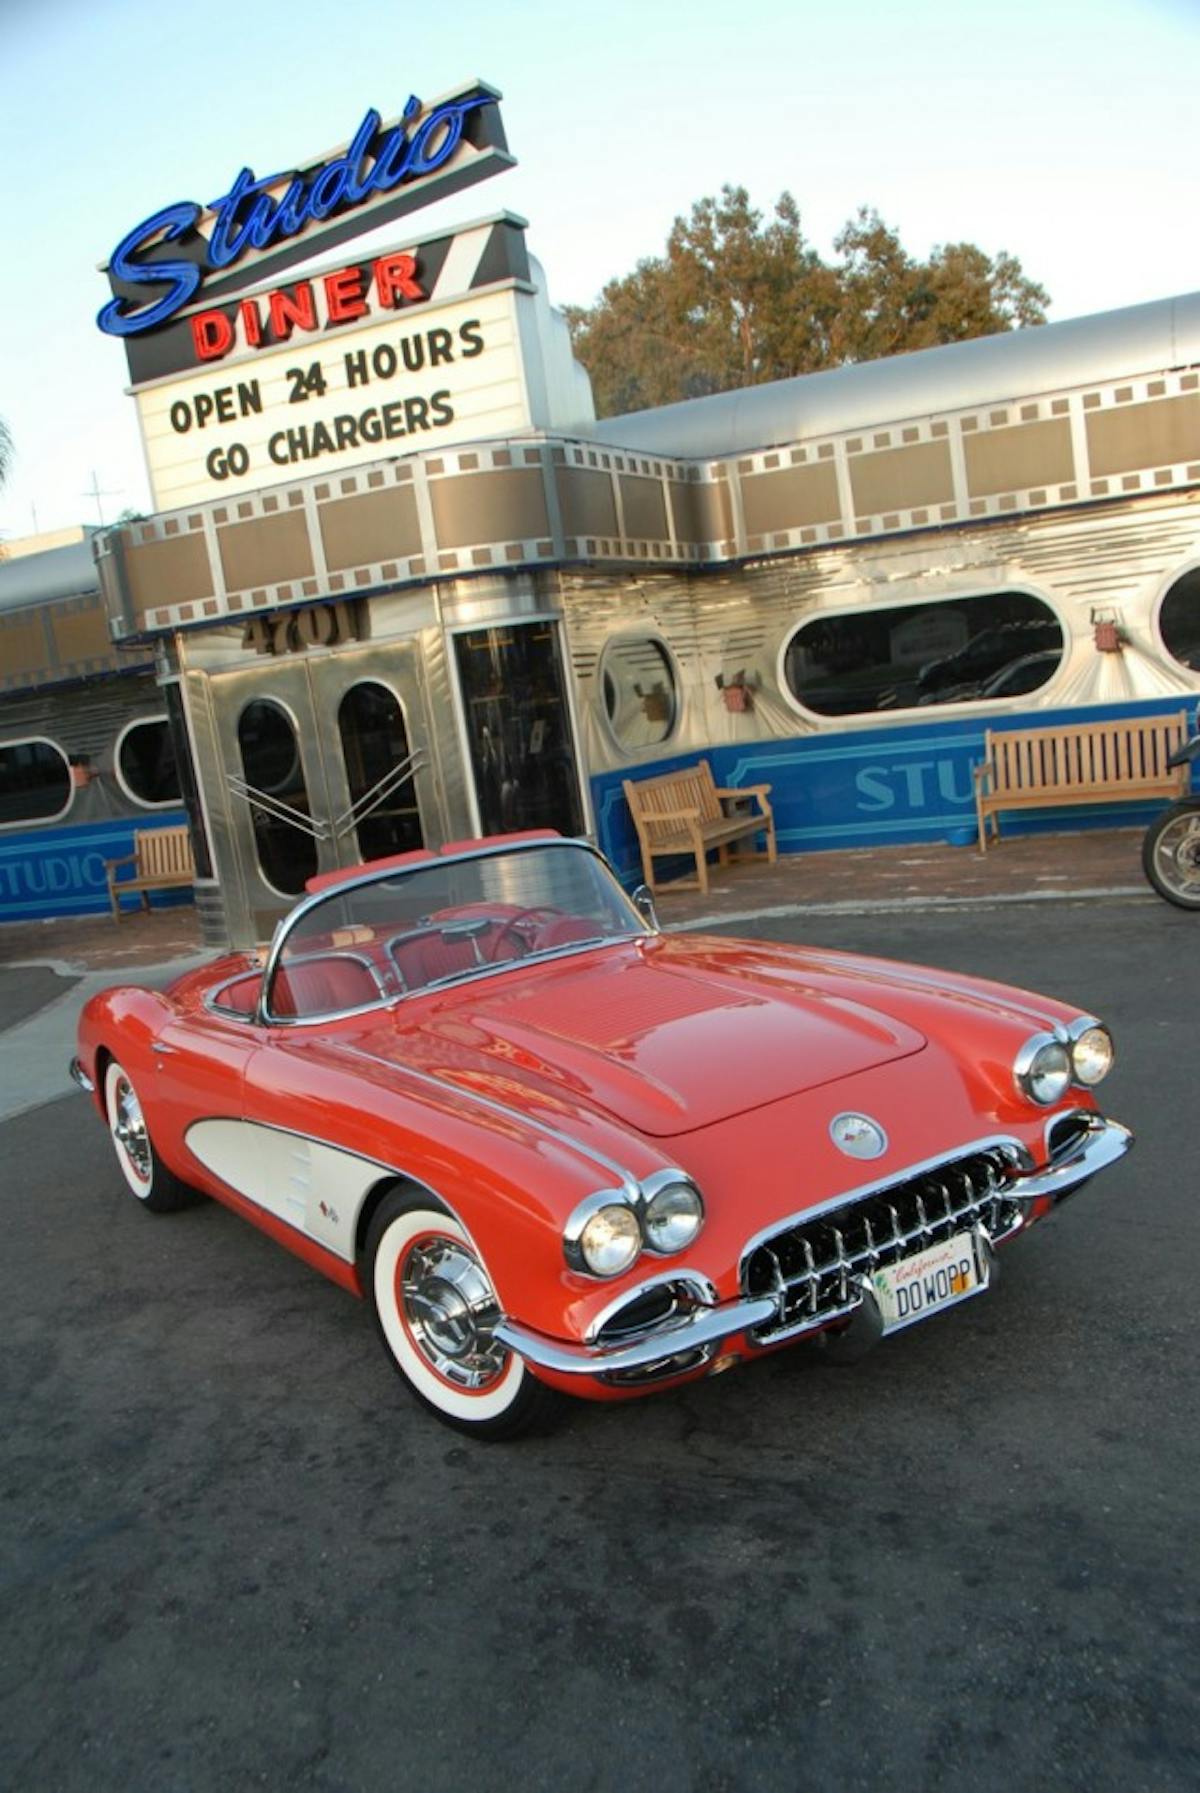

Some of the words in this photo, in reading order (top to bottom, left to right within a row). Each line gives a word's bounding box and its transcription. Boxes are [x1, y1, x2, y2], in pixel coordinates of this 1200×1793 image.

[97, 94, 499, 337] Studio
[191, 254, 424, 361] DINER
[170, 379, 263, 434] OPEN
[286, 362, 327, 404] 24
[345, 320, 485, 388] HOURS
[206, 443, 250, 481] GO
[268, 390, 454, 466] CHARGERS
[856, 757, 983, 811] STU
[0, 852, 107, 896] TUDIO
